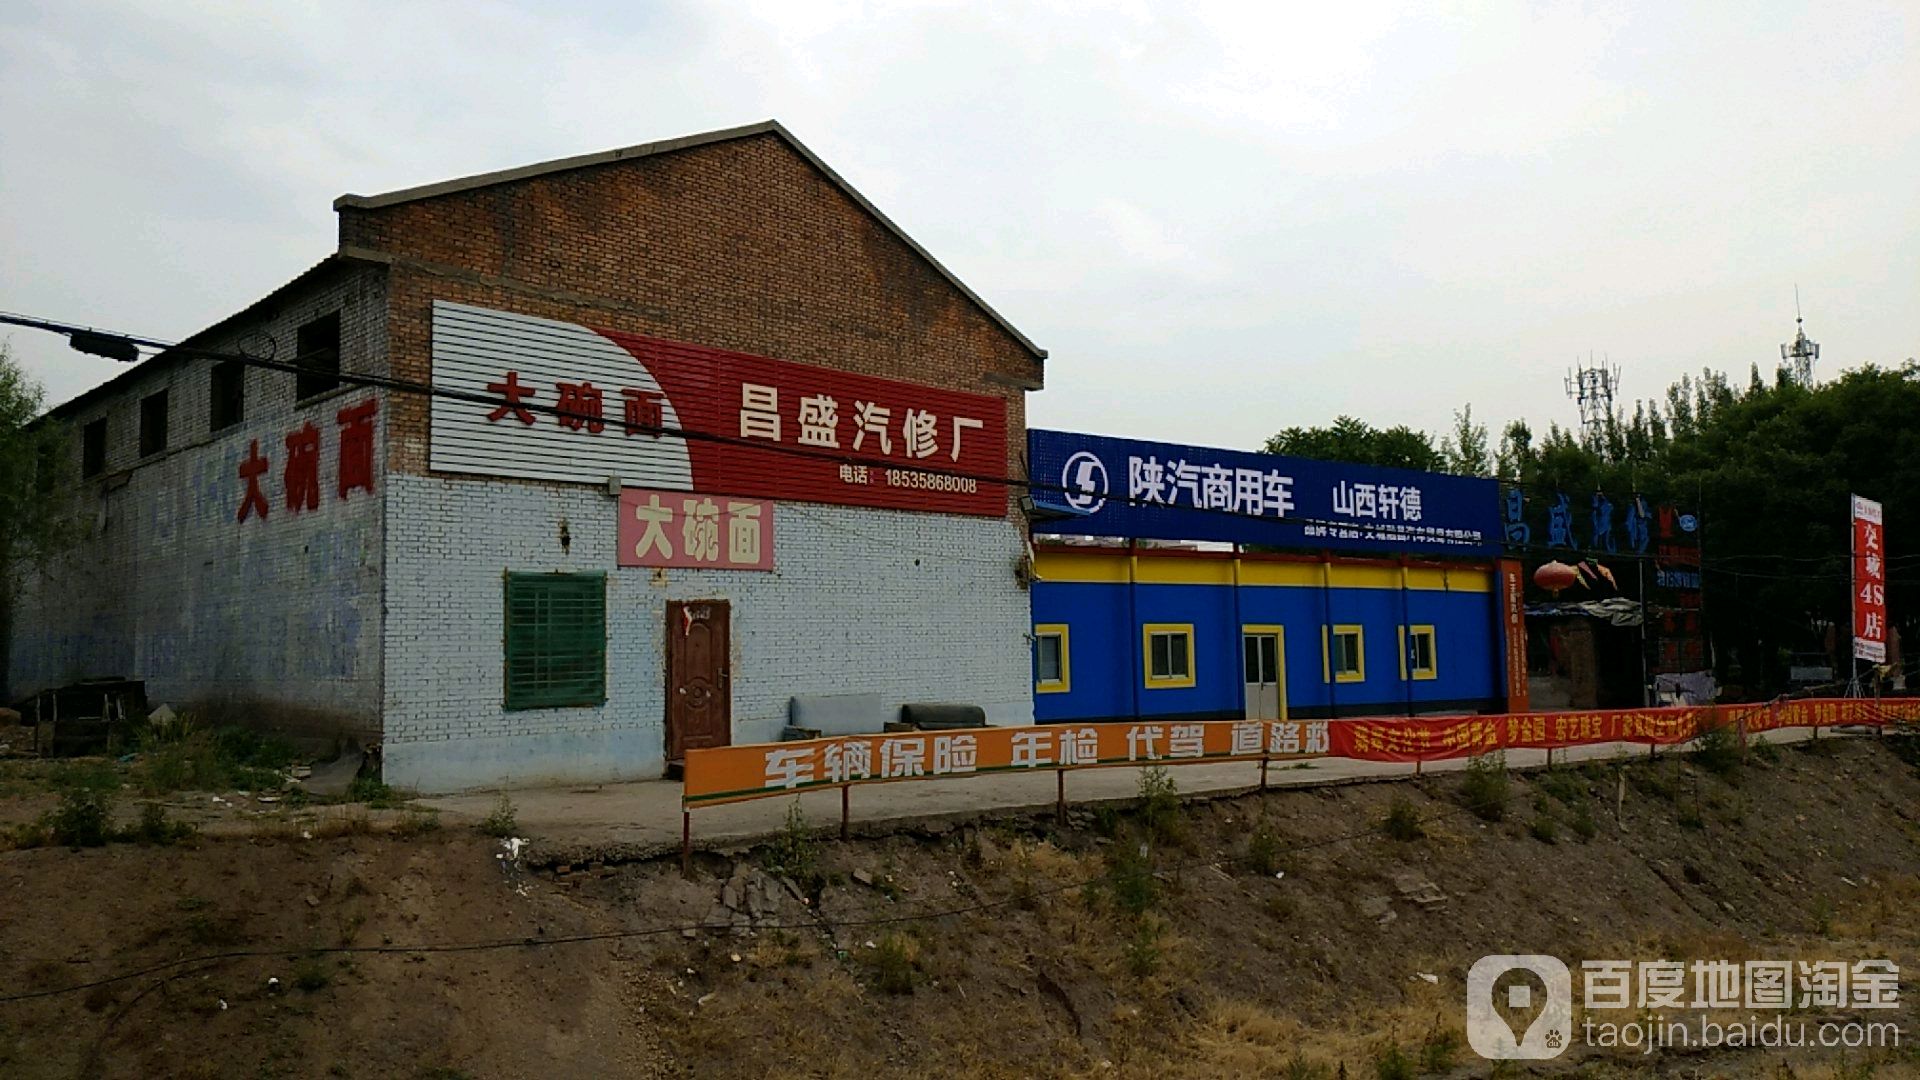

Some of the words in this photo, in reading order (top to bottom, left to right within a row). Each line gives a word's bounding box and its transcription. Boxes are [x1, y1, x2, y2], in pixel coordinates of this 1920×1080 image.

[487, 370, 664, 439] 大碗面
[740, 382, 984, 462] 昌盛汽修厂
[237, 398, 379, 524] 大碗面
[885, 468, 977, 493] 18535868008
[1129, 456, 1295, 518] 陕汽商用车
[635, 494, 762, 565] 大碗面
[1332, 480, 1422, 521] 山西轩德
[765, 735, 978, 788] 车辆保险
[1011, 727, 1098, 767] 年检
[1126, 724, 1205, 761] 代驾
